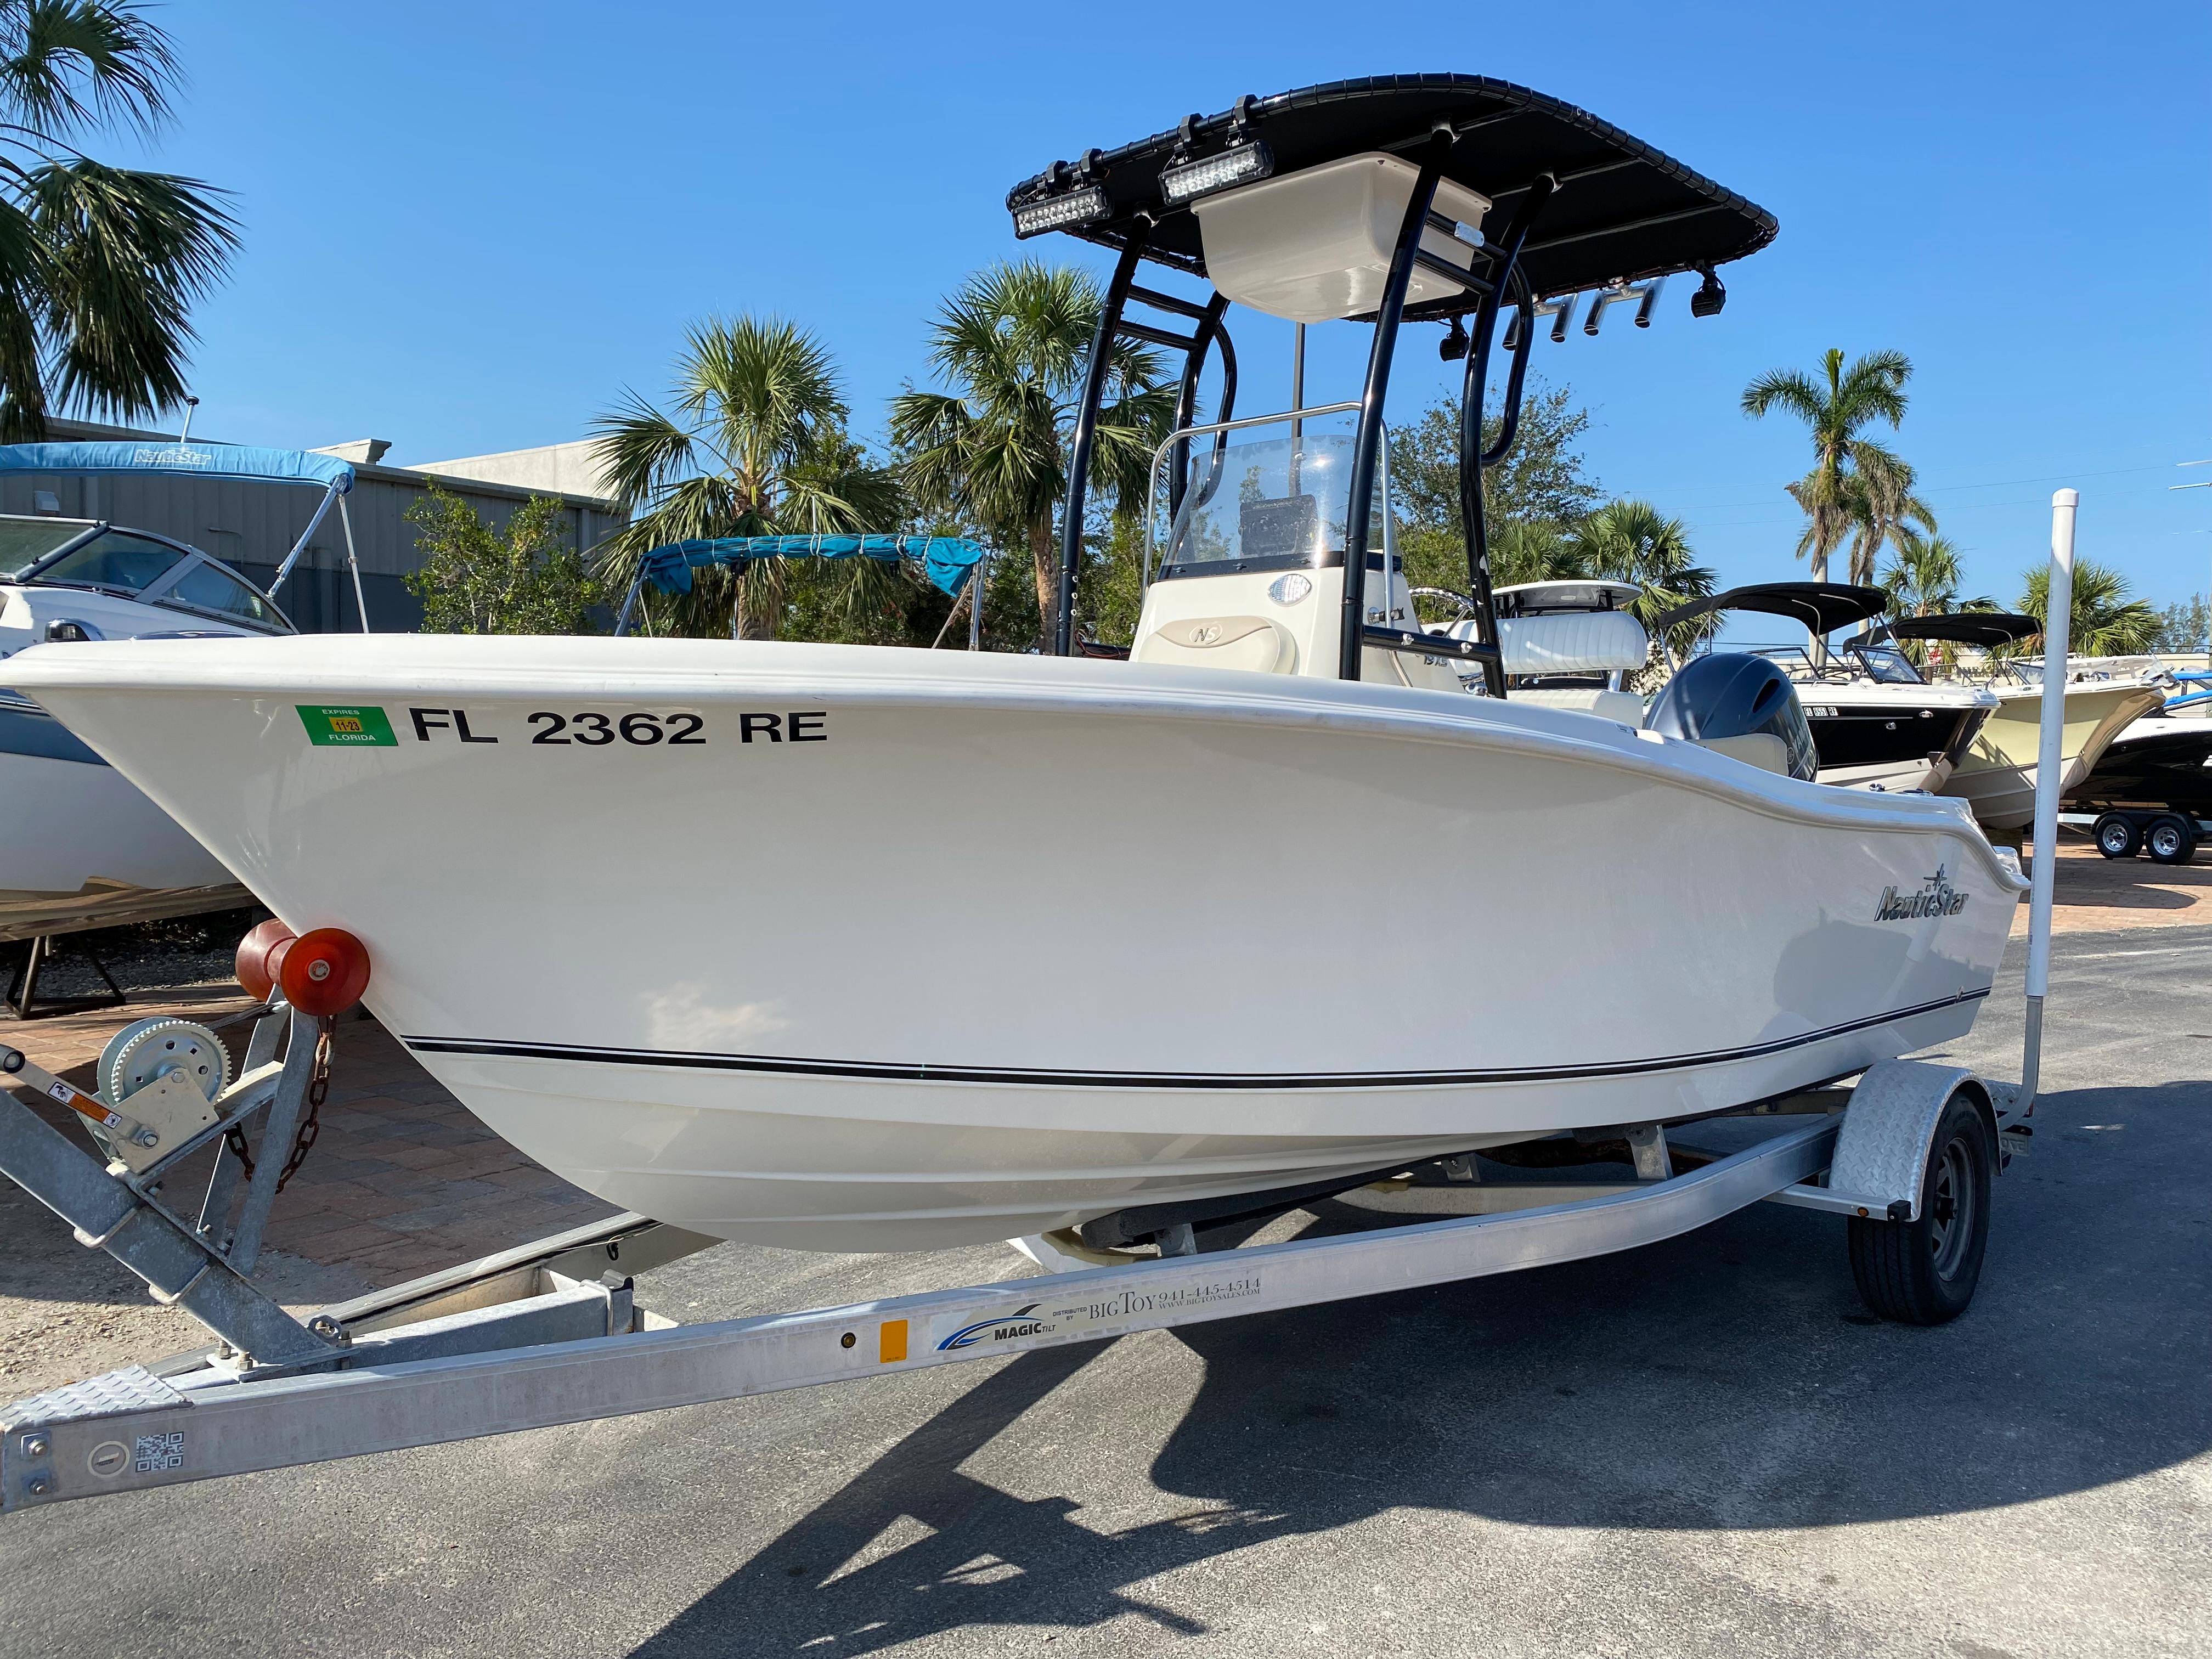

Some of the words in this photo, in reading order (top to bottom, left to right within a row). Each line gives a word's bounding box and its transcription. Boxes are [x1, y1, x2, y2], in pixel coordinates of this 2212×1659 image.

[135, 449, 211, 465] NauticStar
[336, 721, 360, 731] 11-23
[409, 708, 499, 743] FL
[528, 712, 707, 745] 2362
[740, 712, 827, 743] RE
[1874, 884, 1970, 921] NauticStar
[1159, 1278, 1261, 1303] 941-445-4514
[1159, 1288, 1260, 1309] WWW.BIGTOYSALES.COM
[1052, 1307, 1087, 1317] DISTRIBUTED
